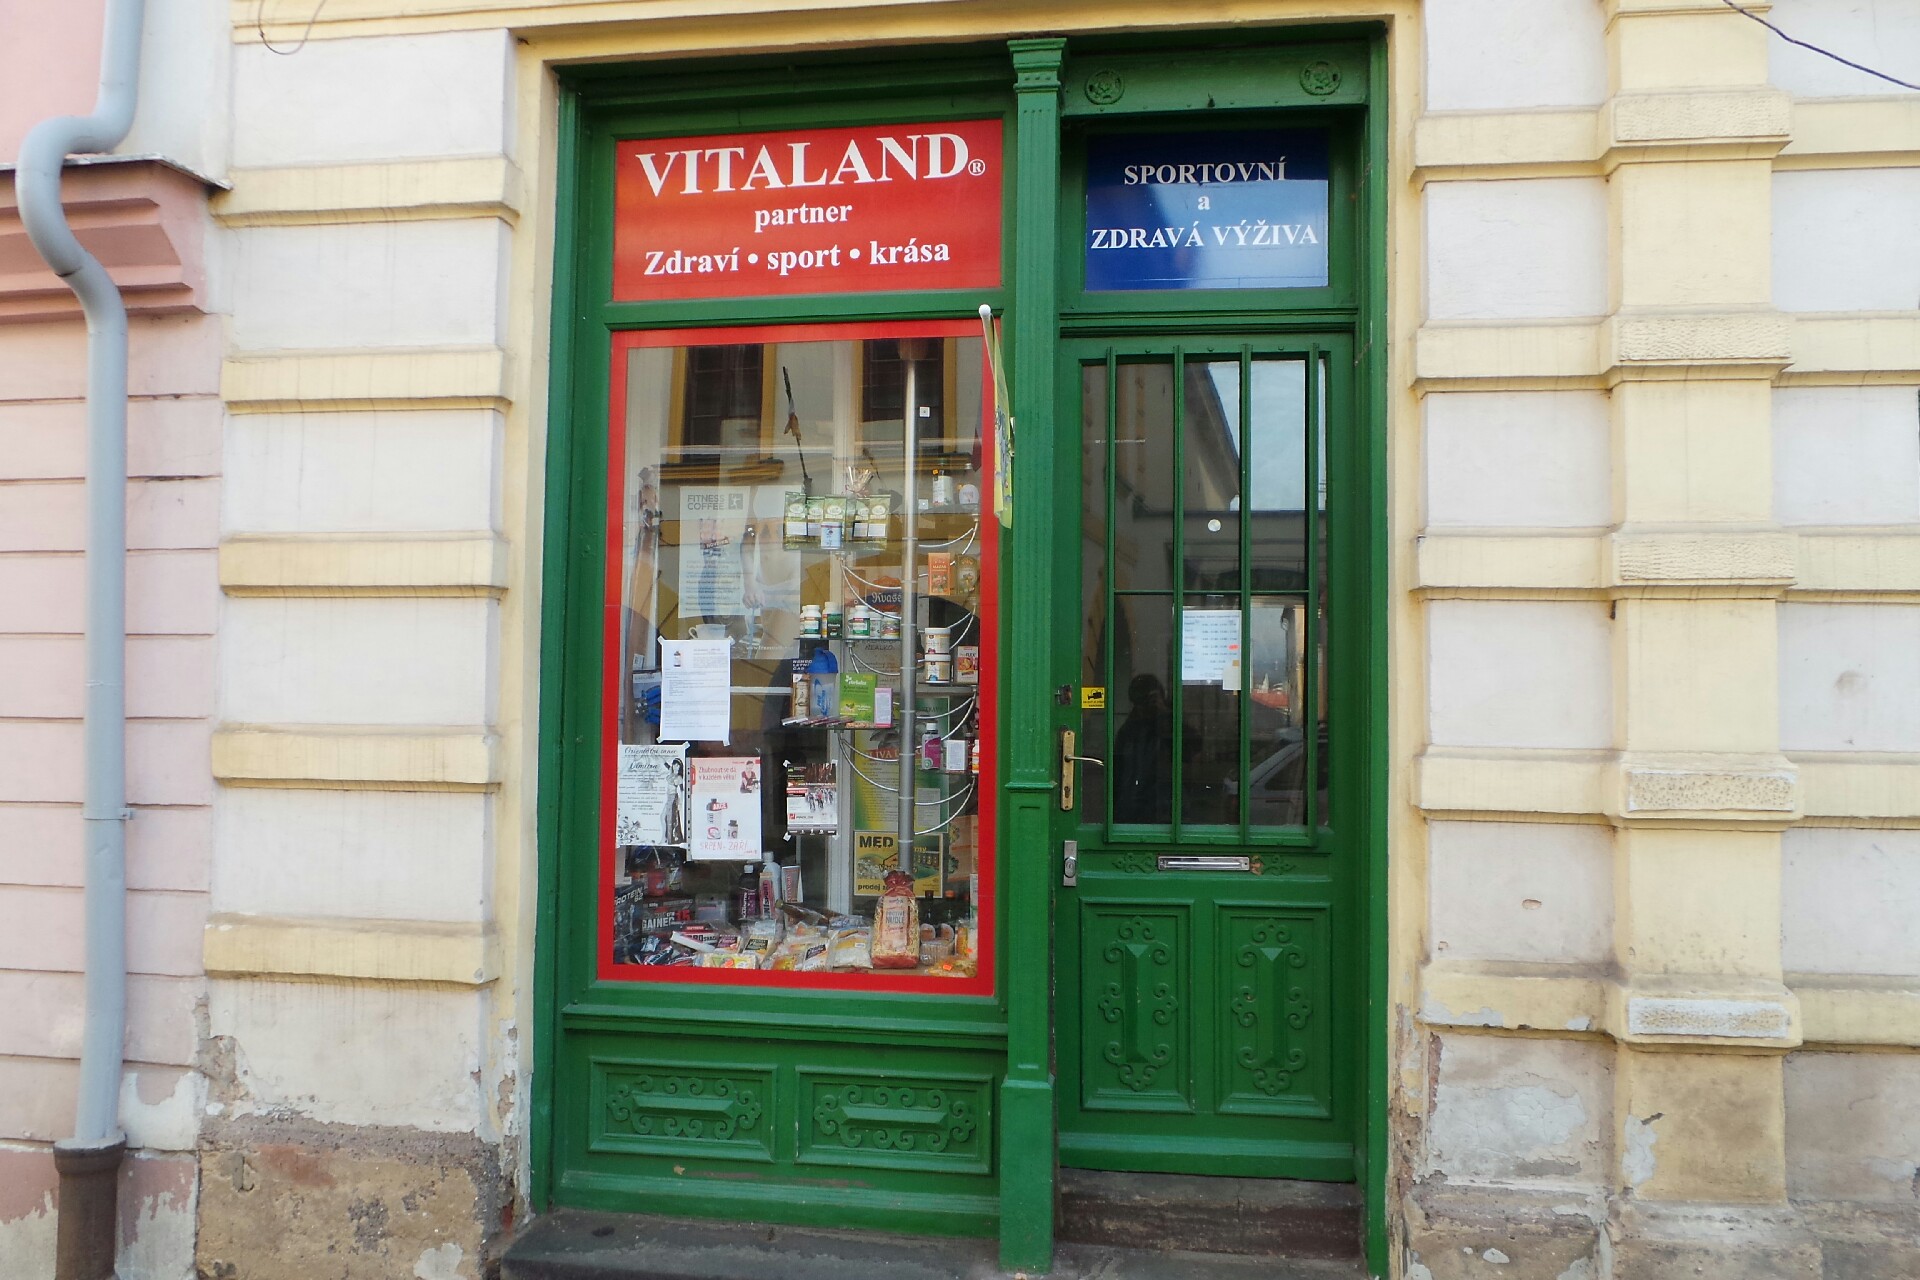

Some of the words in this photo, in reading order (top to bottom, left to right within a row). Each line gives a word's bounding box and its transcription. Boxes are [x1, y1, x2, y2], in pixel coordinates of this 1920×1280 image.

[1124, 156, 1287, 185] SPORTOVNÍ
[1197, 195, 1211, 211] a
[754, 204, 853, 233] partner
[1091, 221, 1204, 249] ZDRAVÁ
[1212, 219, 1318, 246] VÝŽIVA
[644, 247, 741, 276] Zdraví
[767, 244, 841, 276] sport
[869, 238, 951, 265] krása
[687, 494, 725, 503] FITNESS
[687, 502, 725, 511] COFFEE
[859, 835, 894, 848] MED
[857, 883, 881, 891] prodej
